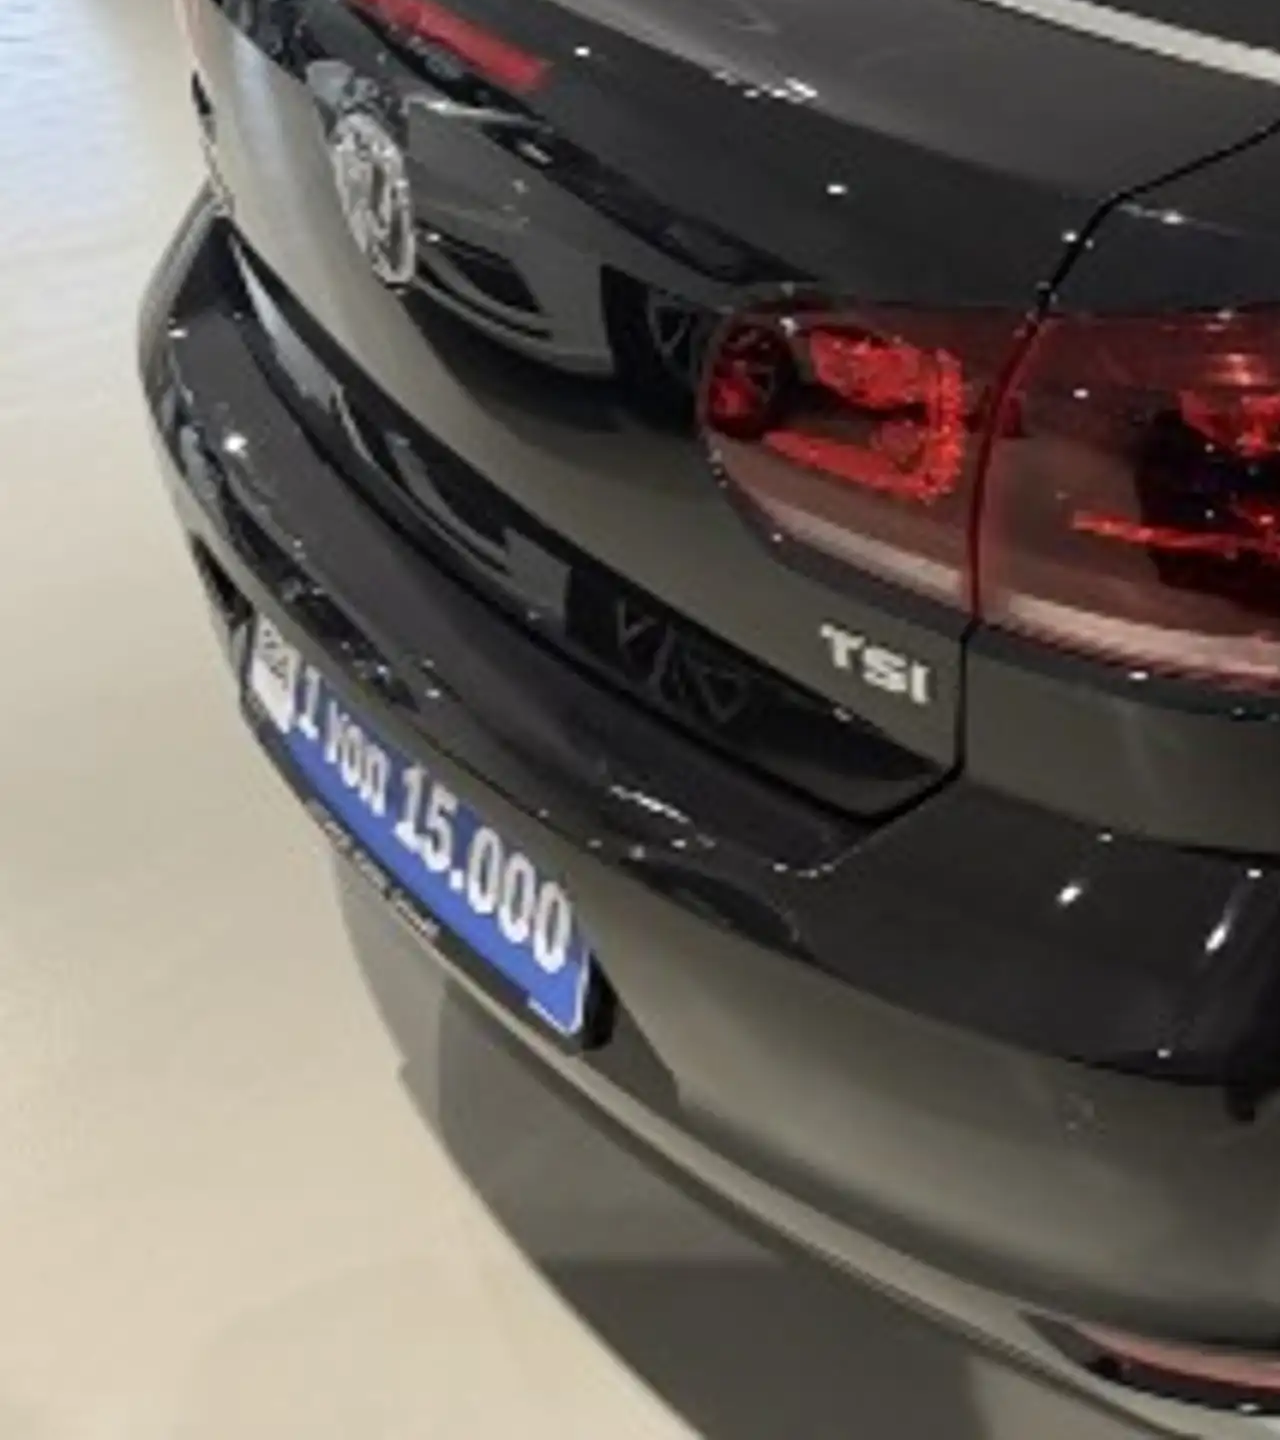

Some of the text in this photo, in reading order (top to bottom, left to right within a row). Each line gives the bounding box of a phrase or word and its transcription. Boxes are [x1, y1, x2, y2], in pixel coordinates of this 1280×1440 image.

[820, 624, 930, 704] TSI
[325, 698, 391, 817] von
[393, 763, 572, 975] 15.000
